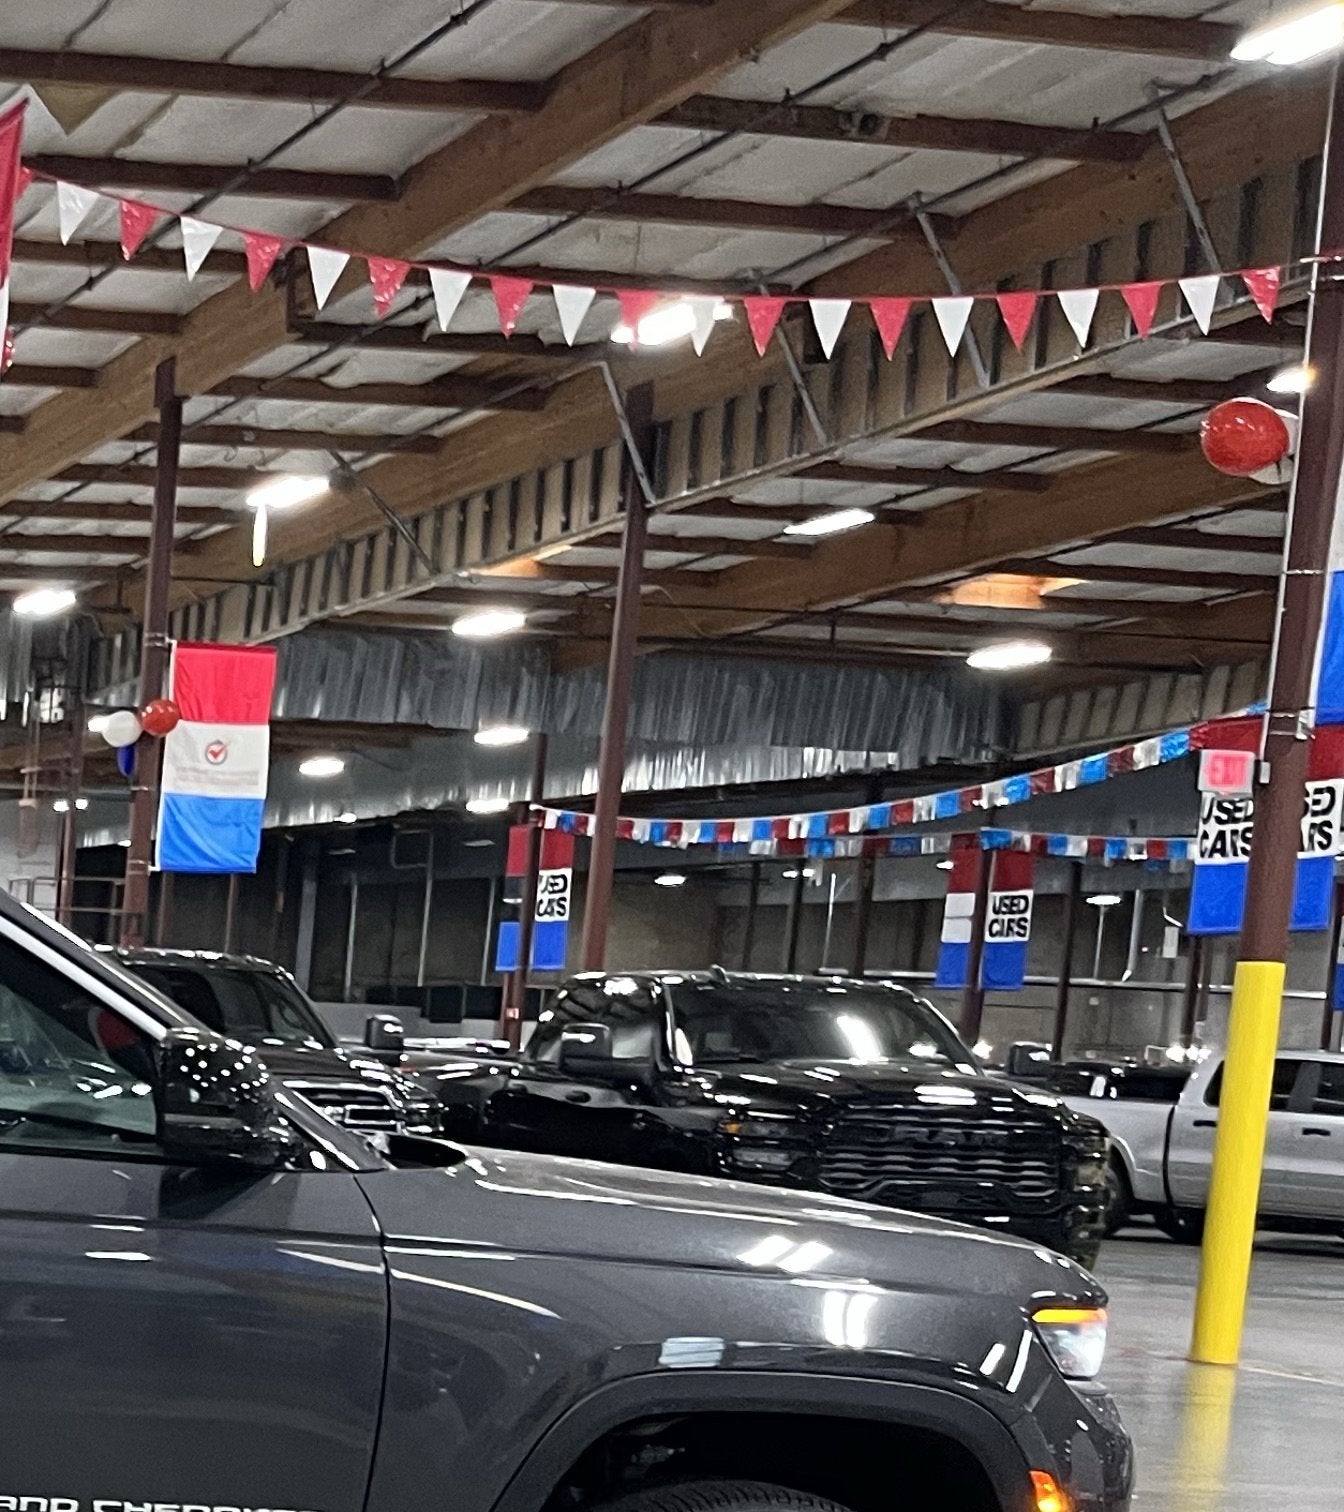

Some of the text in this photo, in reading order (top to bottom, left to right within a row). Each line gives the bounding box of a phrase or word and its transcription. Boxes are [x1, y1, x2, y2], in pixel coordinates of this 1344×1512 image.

[1304, 786, 1336, 818] ED
[992, 895, 1029, 915] USED
[988, 917, 1028, 938] CARS
